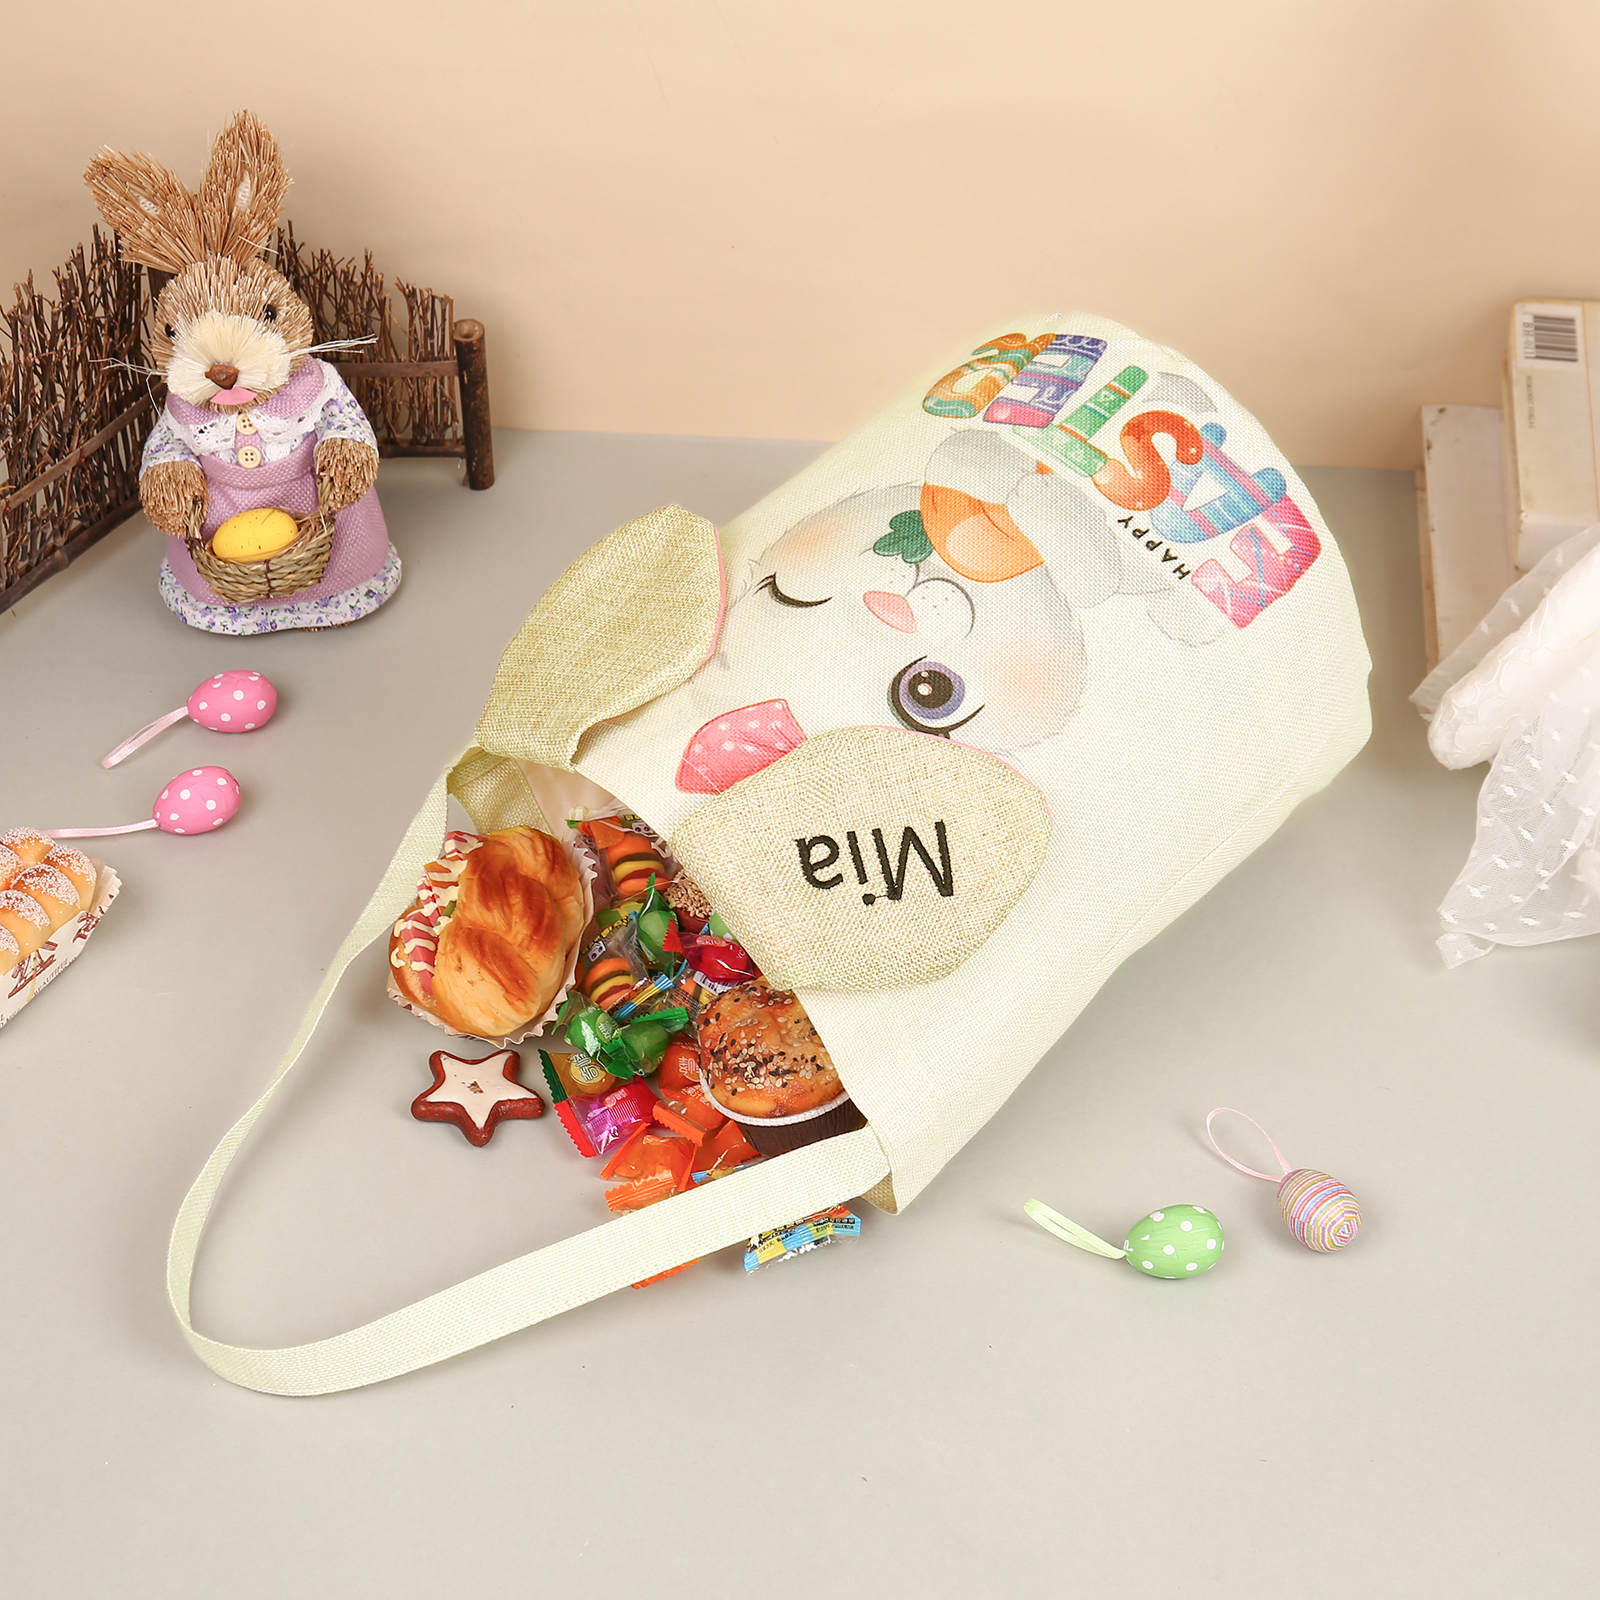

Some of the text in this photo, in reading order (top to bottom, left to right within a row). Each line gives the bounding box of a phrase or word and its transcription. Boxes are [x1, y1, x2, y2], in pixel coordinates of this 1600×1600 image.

[922, 333, 1322, 629] EASTER
[1117, 513, 1193, 581] HAPPY
[794, 819, 954, 906] Mia
